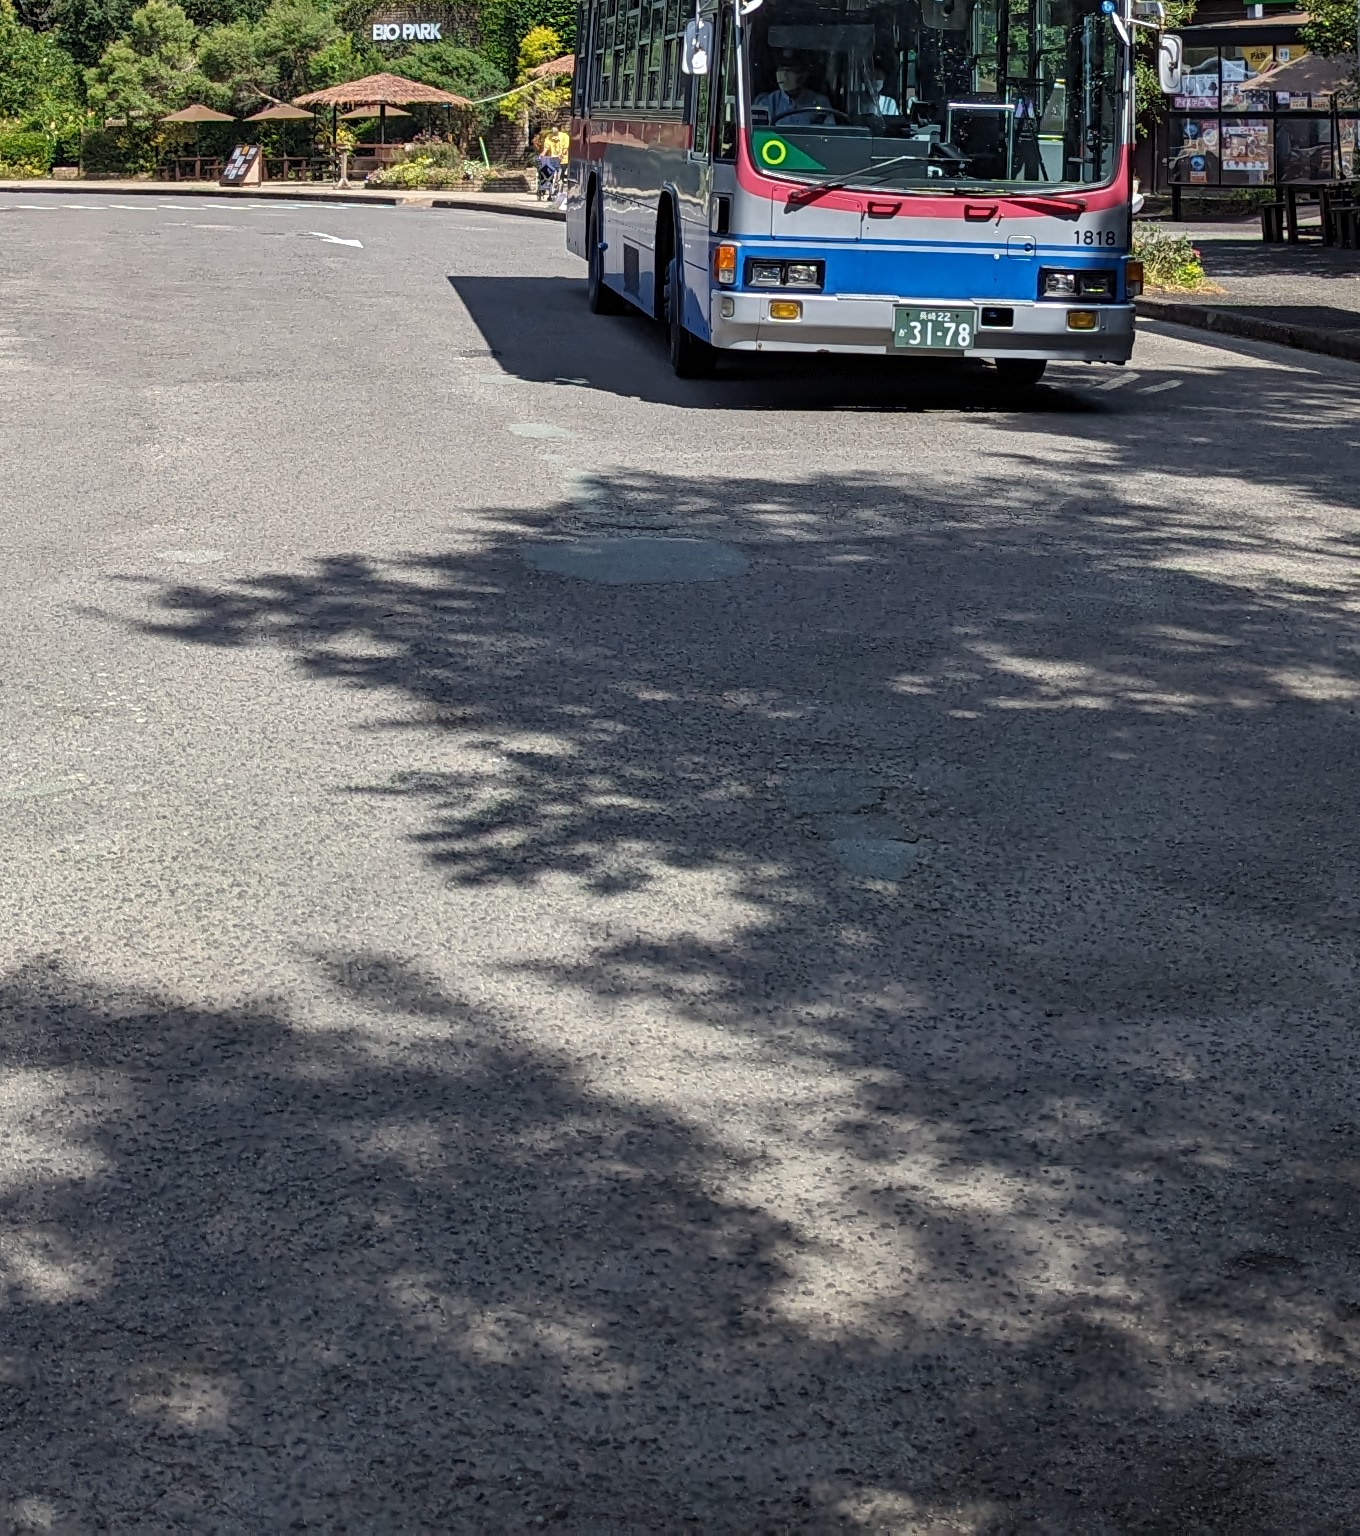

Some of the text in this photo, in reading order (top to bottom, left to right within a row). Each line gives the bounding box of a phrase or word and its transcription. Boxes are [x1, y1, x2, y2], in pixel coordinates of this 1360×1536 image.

[372, 22, 443, 41] BIO PARK
[1073, 230, 1116, 246] 1818
[908, 321, 971, 347] 31-78
